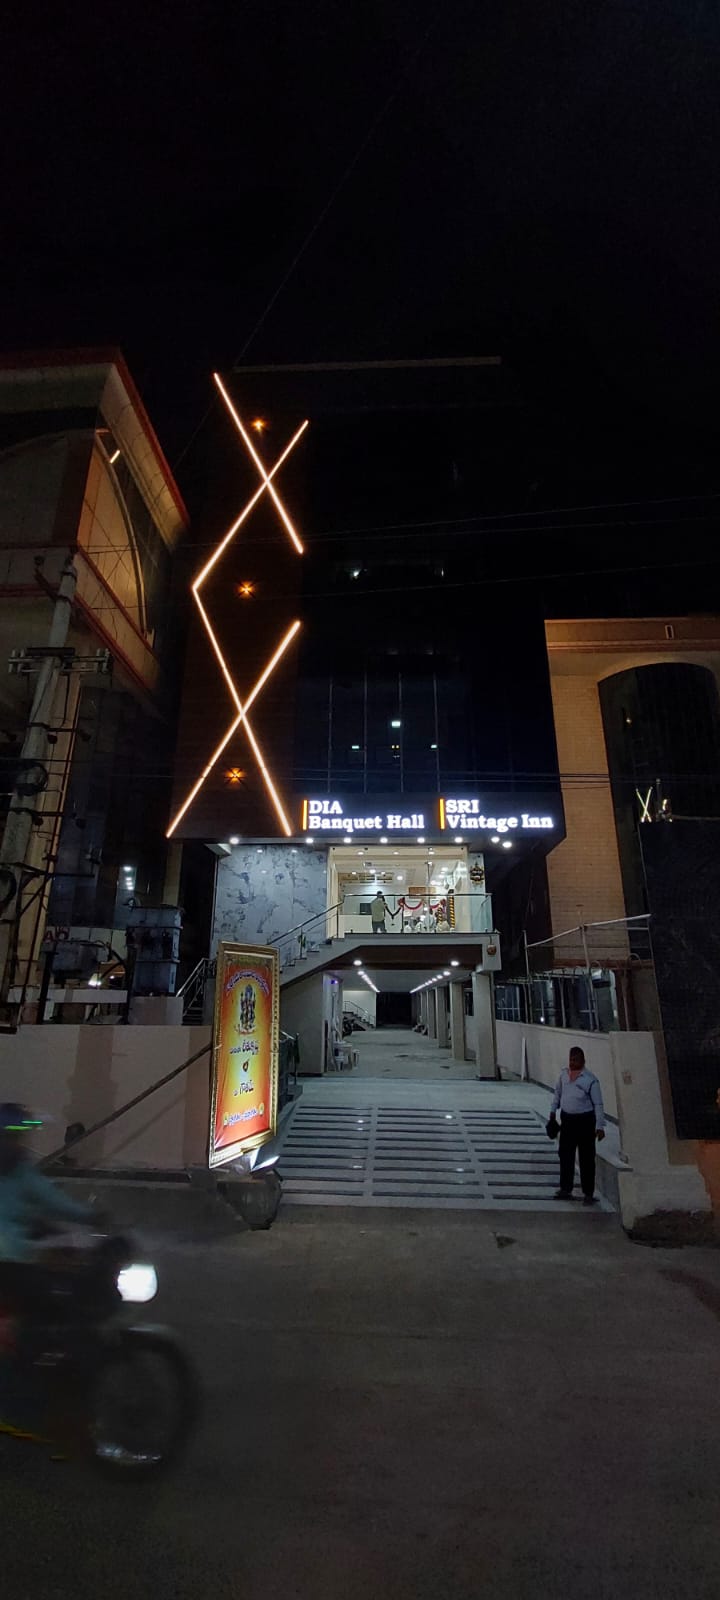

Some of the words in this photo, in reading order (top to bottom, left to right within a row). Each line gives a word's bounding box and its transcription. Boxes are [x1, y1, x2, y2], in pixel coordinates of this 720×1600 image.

[308, 799, 343, 814] DIA
[445, 798, 479, 814] SRI
[308, 814, 382, 833] Banquet
[386, 814, 424, 830] Hall
[445, 814, 518, 833] Vintage
[521, 813, 554, 829] Inn
